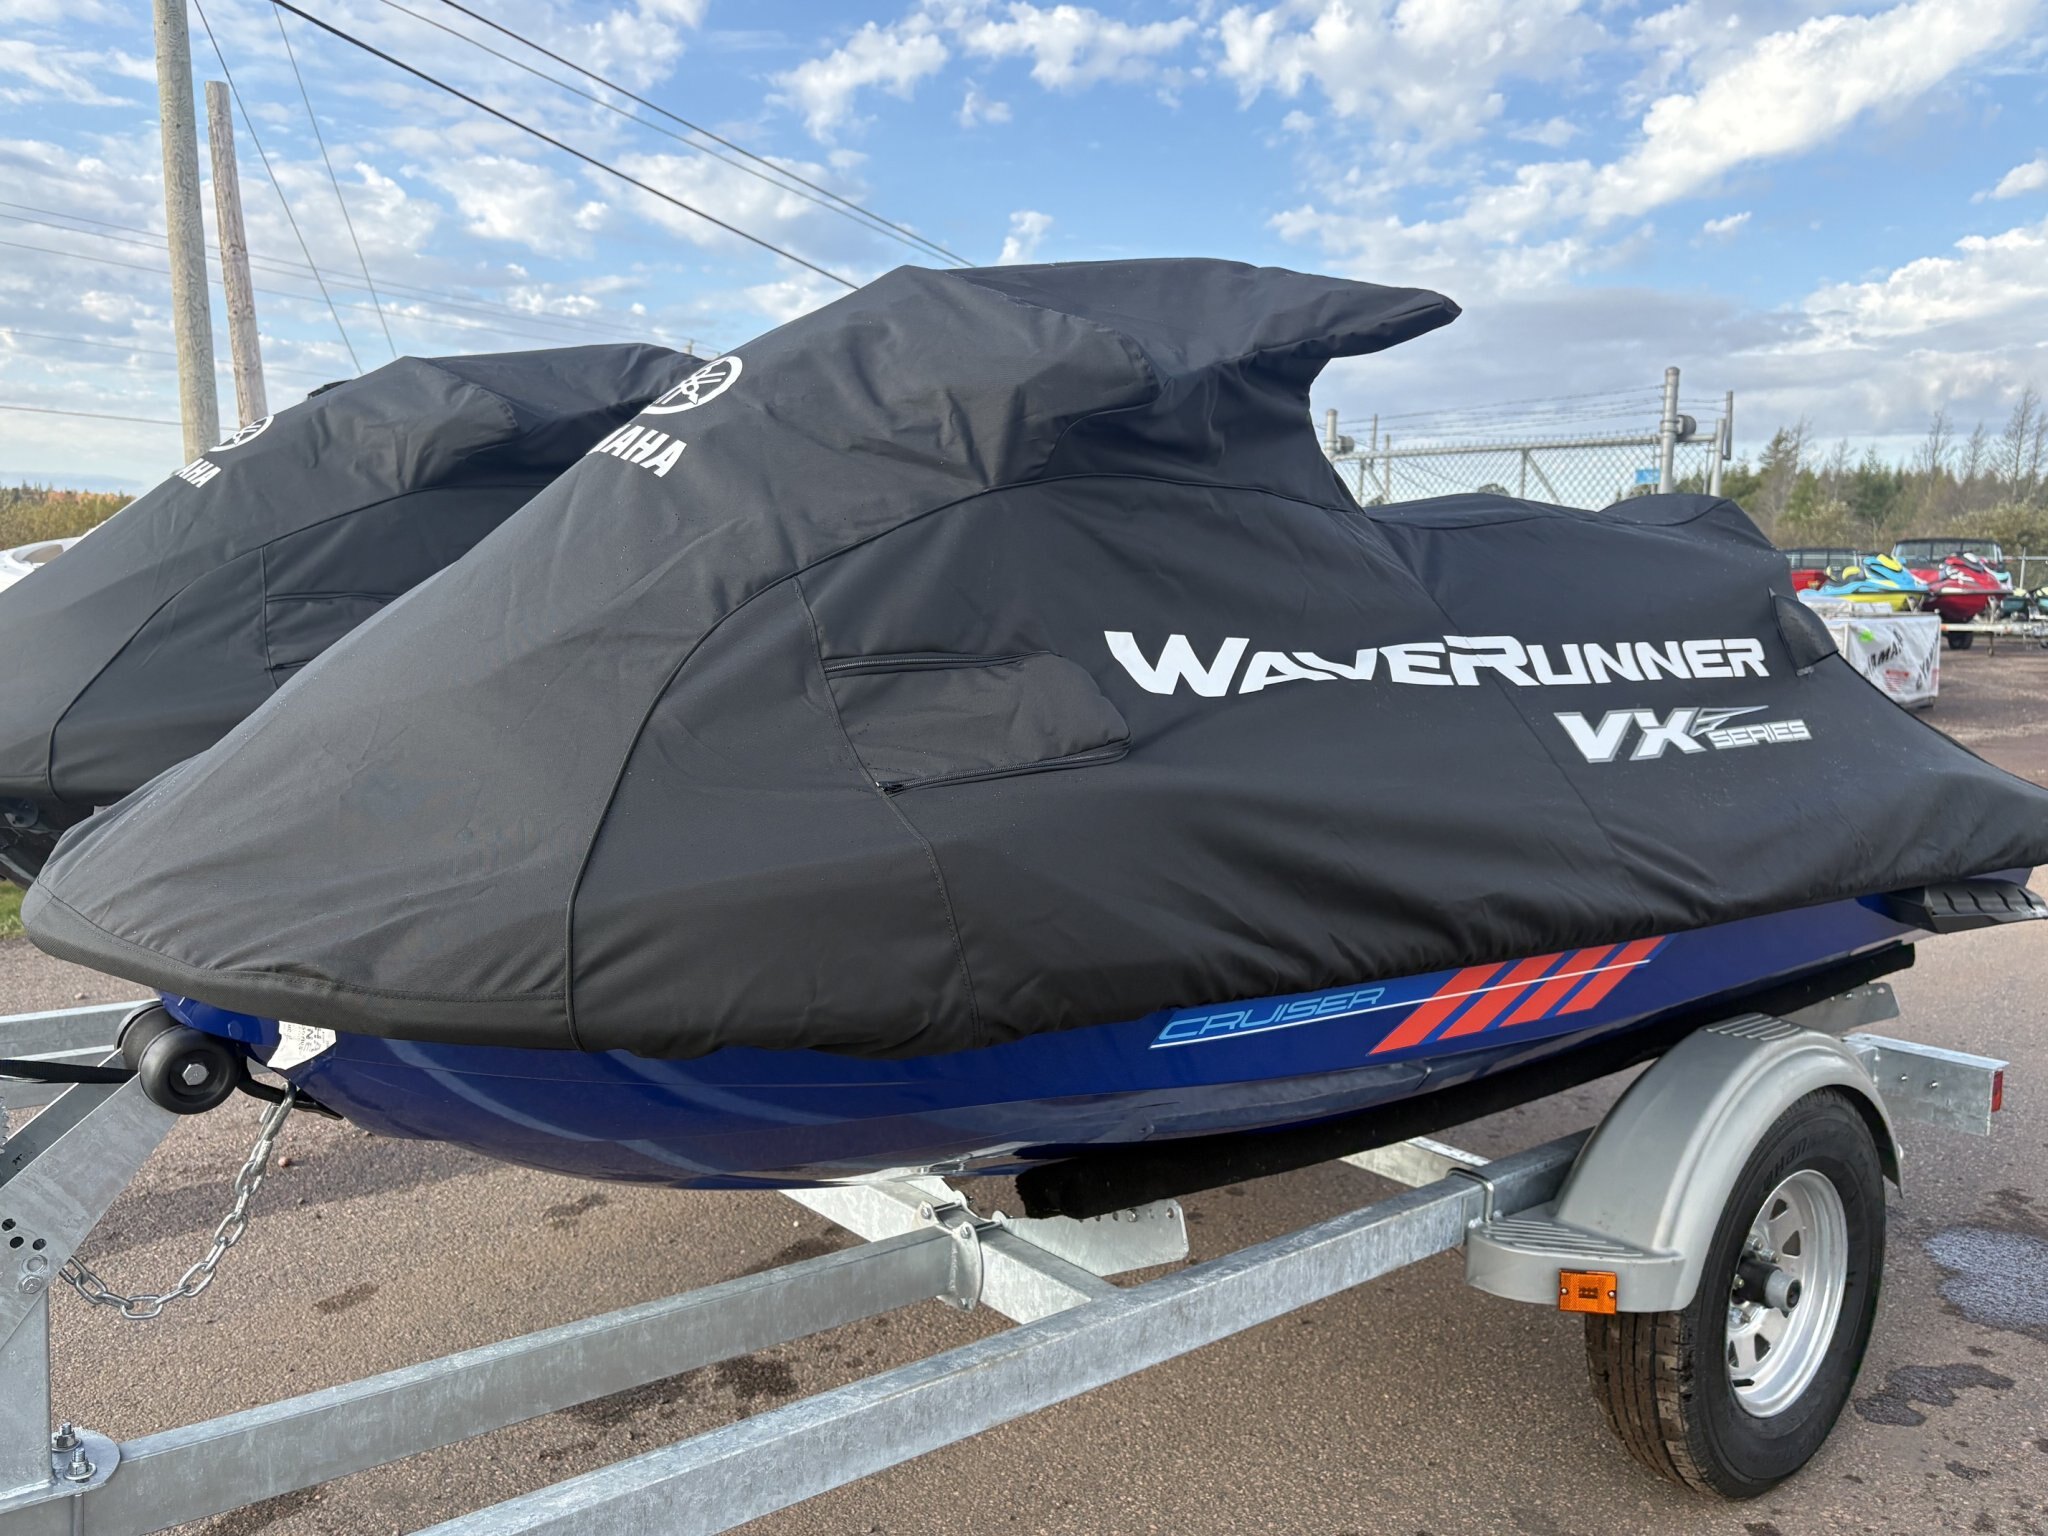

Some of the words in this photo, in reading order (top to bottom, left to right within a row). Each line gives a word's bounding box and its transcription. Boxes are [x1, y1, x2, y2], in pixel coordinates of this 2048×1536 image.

[1554, 707, 1708, 763] VX
[1708, 719, 1812, 750] SERIES
[1158, 986, 1386, 1041] CRUISER
